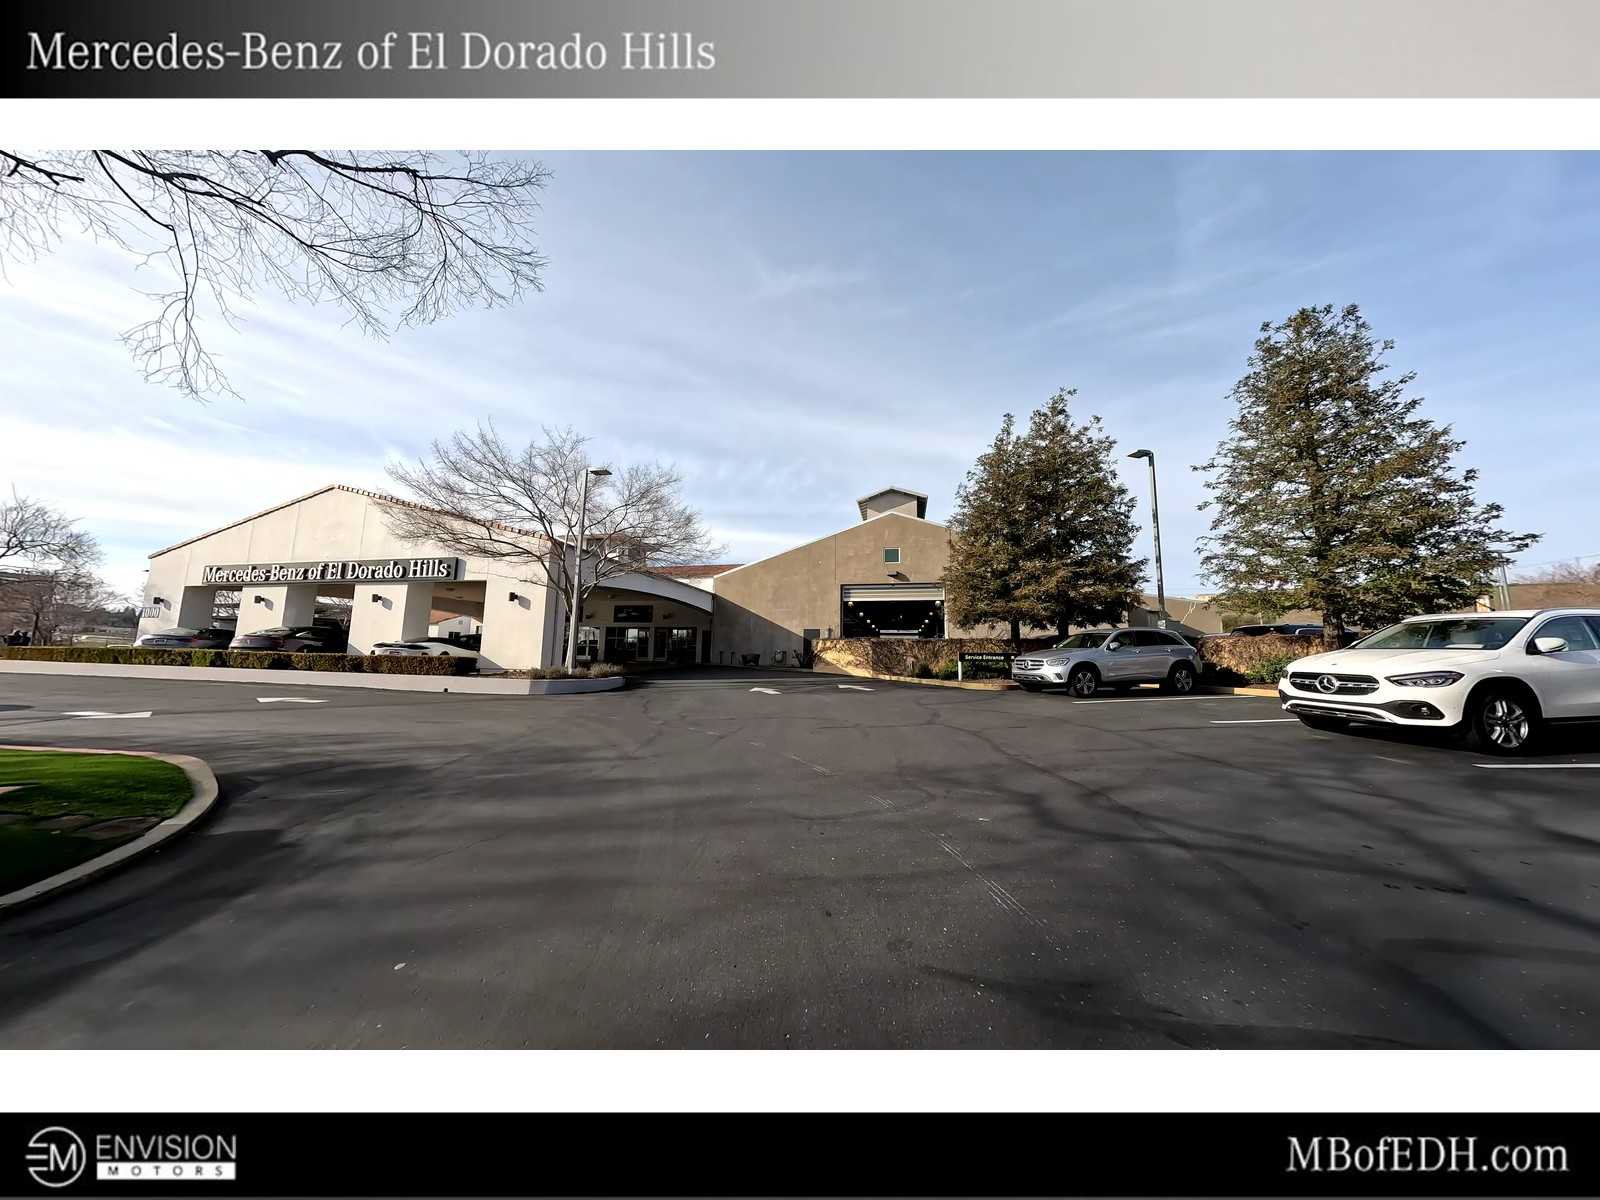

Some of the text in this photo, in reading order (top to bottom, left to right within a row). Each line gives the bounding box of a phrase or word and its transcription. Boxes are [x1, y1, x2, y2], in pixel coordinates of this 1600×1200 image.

[204, 560, 447, 582] Mercedes-Benz of El Dorado Hills
